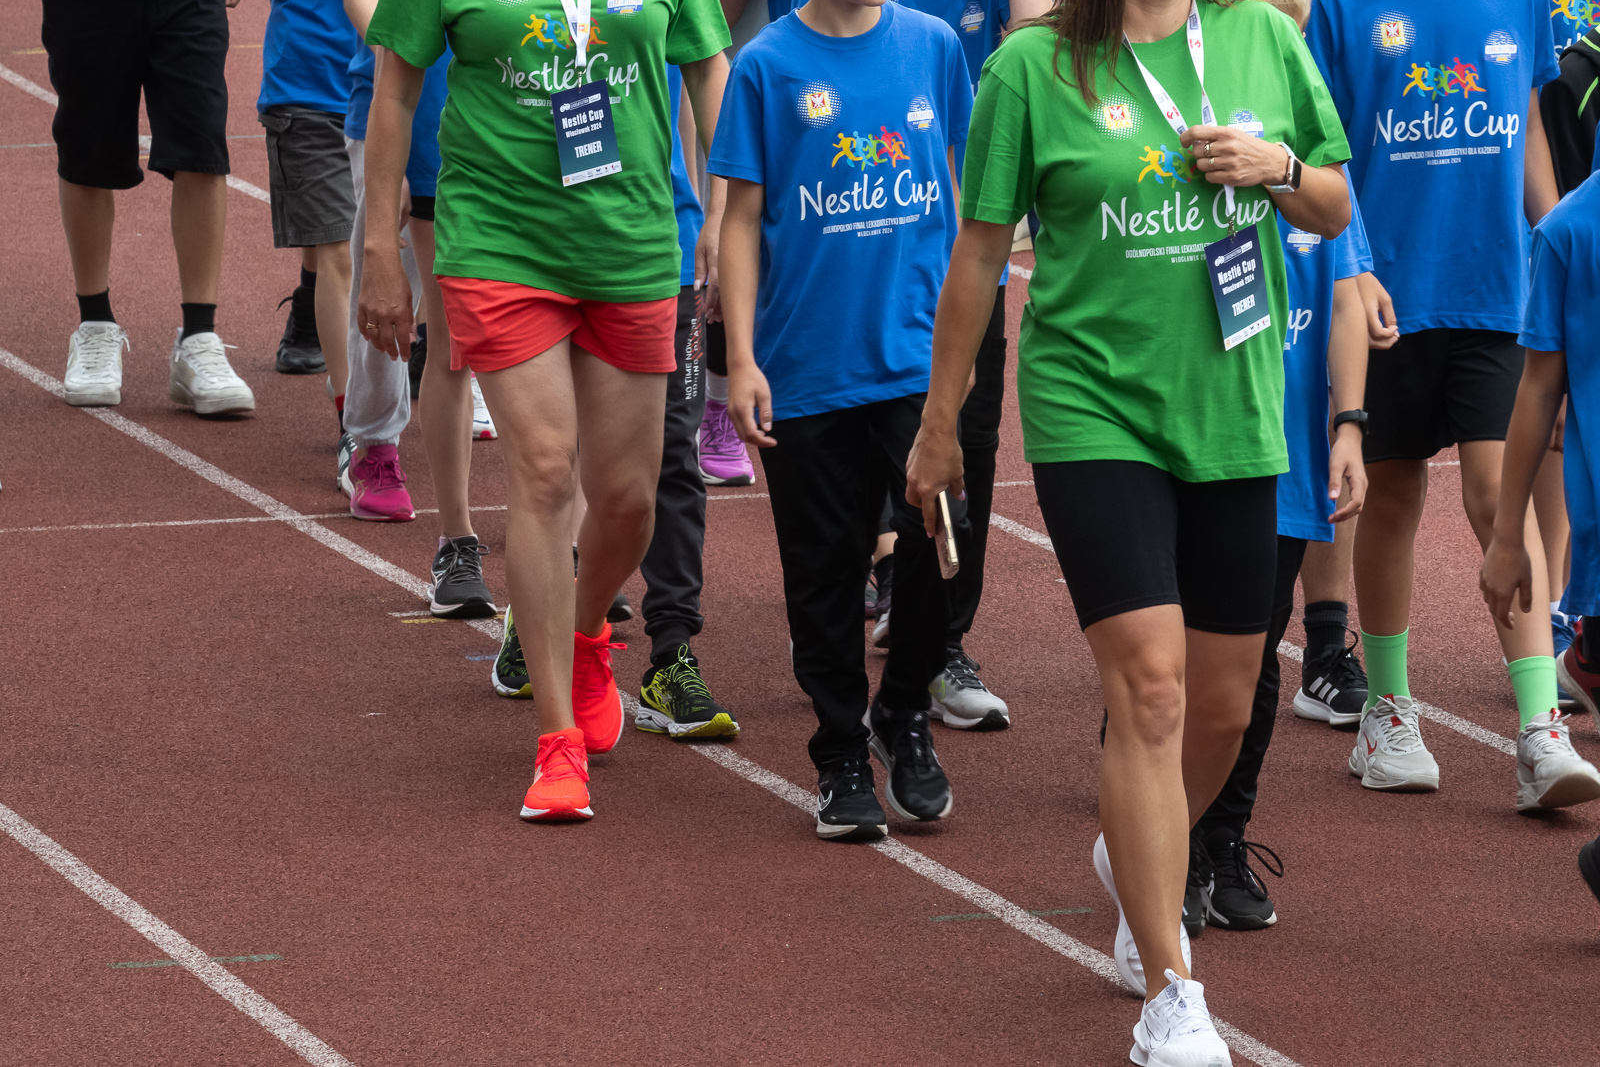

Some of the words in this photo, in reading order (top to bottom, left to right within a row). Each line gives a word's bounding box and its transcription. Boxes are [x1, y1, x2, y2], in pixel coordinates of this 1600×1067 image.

[495, 56, 583, 92] Nestlé
[586, 53, 639, 96] Cup
[562, 112, 587, 129] Nestlé
[588, 109, 604, 121] Cup
[1373, 102, 1457, 147] Nestlé
[1464, 101, 1520, 148] Cup
[574, 140, 603, 159] TRENER
[799, 173, 887, 221] Nestlé
[894, 169, 940, 215] Cup
[1100, 191, 1204, 240] Nestlé
[1212, 188, 1270, 229] Cup
[1125, 247, 1165, 258] OGÓLNOPOLSKI
[1166, 245, 1180, 255] FINAŁ
[1218, 263, 1242, 286] Nestlé
[1242, 258, 1256, 274] Cup
[1232, 294, 1256, 317] TRENER
[1288, 308, 1313, 345] up
